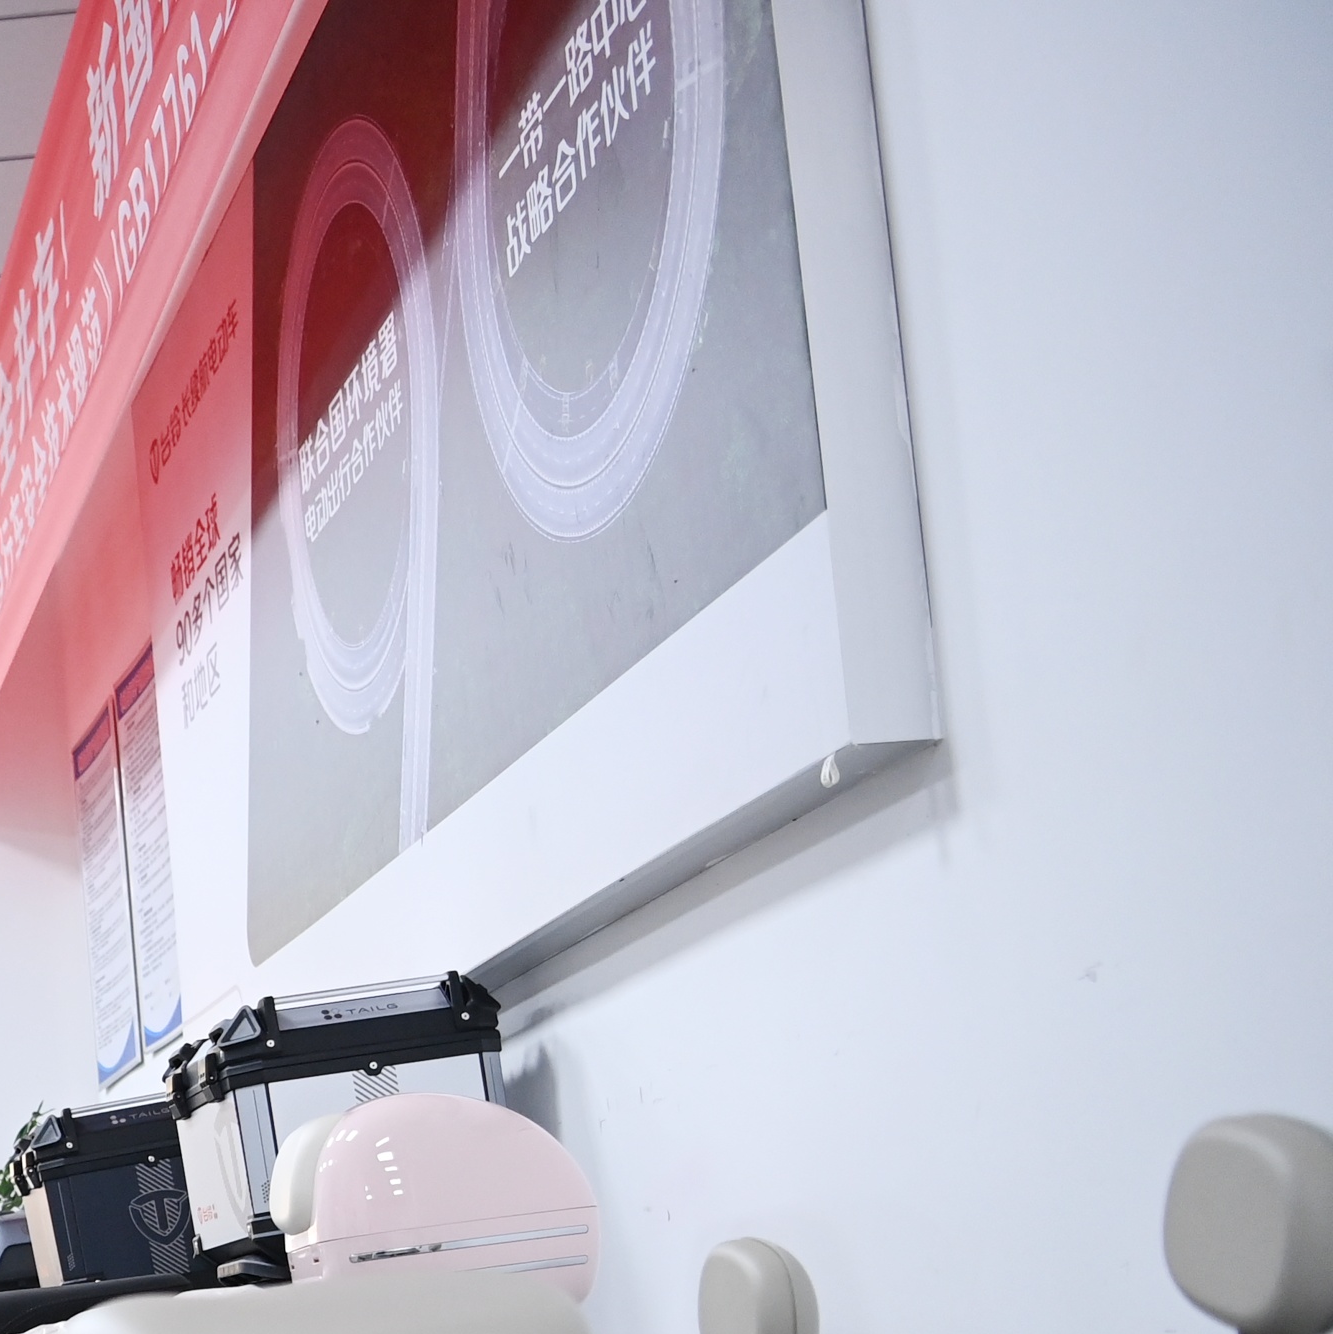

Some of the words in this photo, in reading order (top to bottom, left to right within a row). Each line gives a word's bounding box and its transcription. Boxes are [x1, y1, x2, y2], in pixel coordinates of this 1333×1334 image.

[505, 20, 656, 278] 战略合作伙伴
[182, 299, 238, 426] 长续航电动车
[298, 314, 399, 495] 联合国环境署
[304, 382, 403, 542] 电动出行合作伙伴
[170, 492, 221, 606] 畅销全球
[175, 532, 244, 666] 90多个国家
[181, 642, 221, 730] 和地区
[345, 1002, 399, 1015] TAILG
[129, 1106, 170, 1119] TAILG
